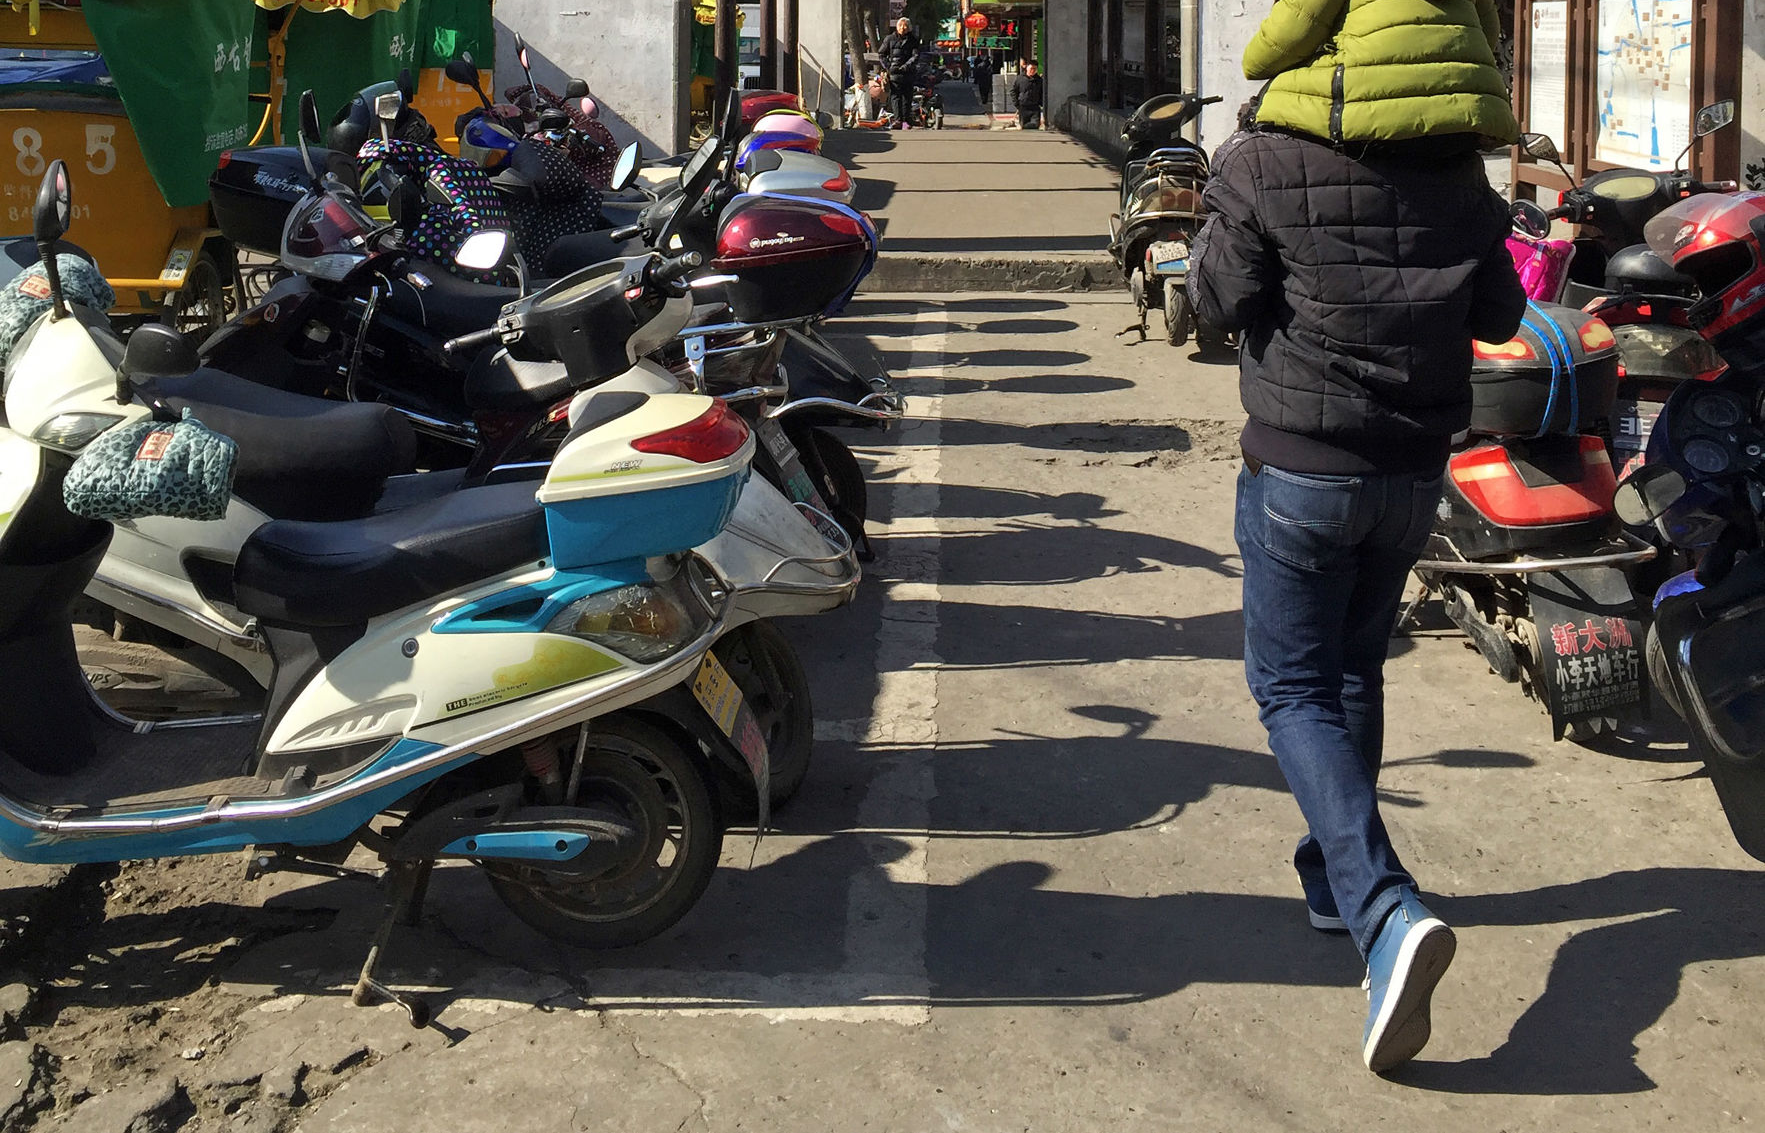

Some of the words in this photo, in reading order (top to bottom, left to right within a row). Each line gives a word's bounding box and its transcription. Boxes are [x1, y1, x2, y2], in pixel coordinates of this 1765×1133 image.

[610, 459, 644, 470] NEW
[1550, 617, 1633, 656] 新大洲
[446, 698, 468, 712] THE
